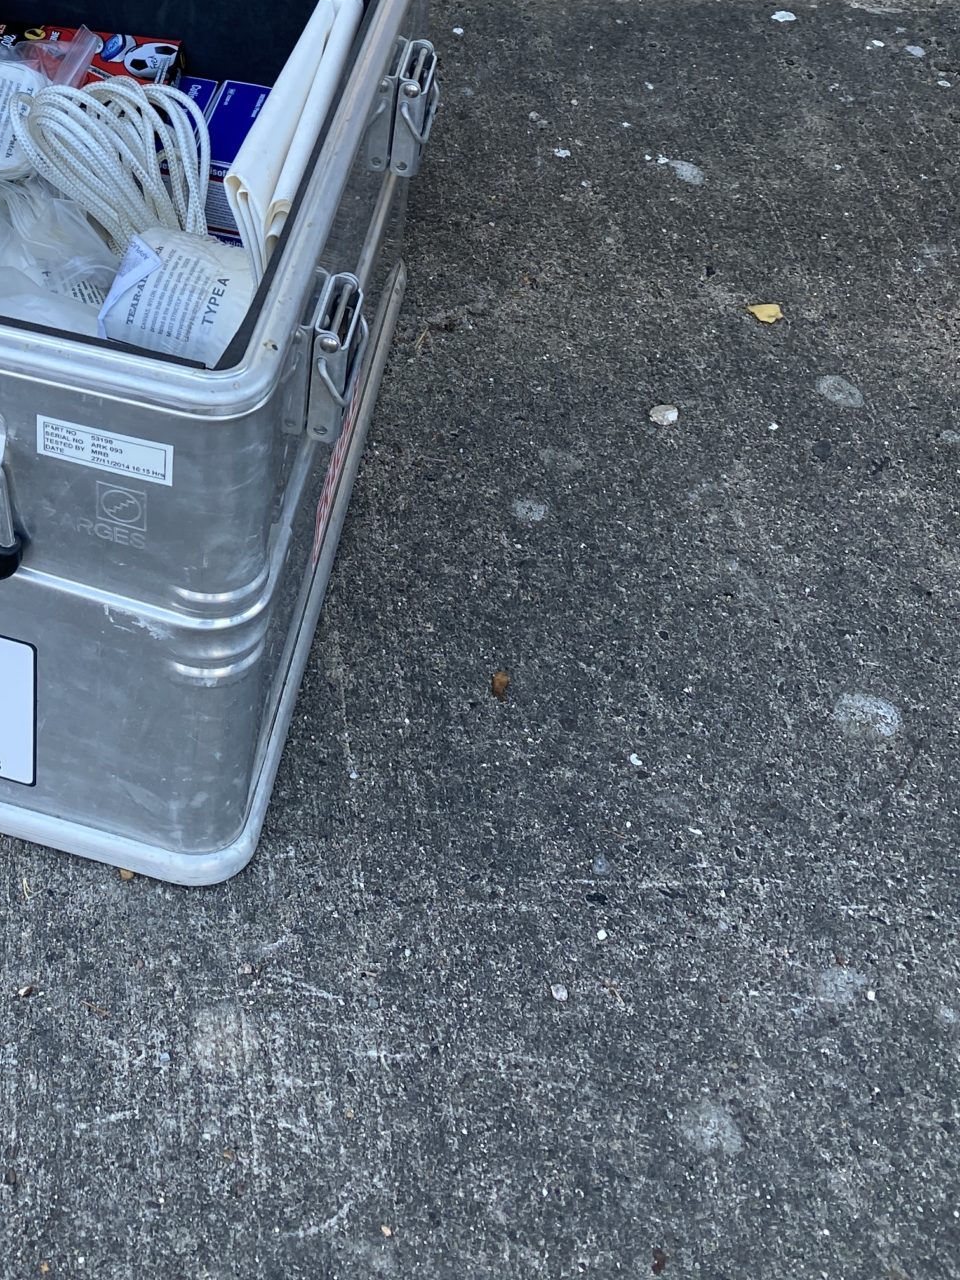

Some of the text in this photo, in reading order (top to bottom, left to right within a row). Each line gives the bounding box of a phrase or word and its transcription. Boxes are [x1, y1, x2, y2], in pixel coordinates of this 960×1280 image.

[202, 277, 230, 326] TYPE A
[45, 424, 64, 433] PART
[66, 429, 77, 437] NO
[45, 431, 71, 442] SERIAL
[45, 437, 74, 449] TESTED
[45, 444, 65, 454] DATE
